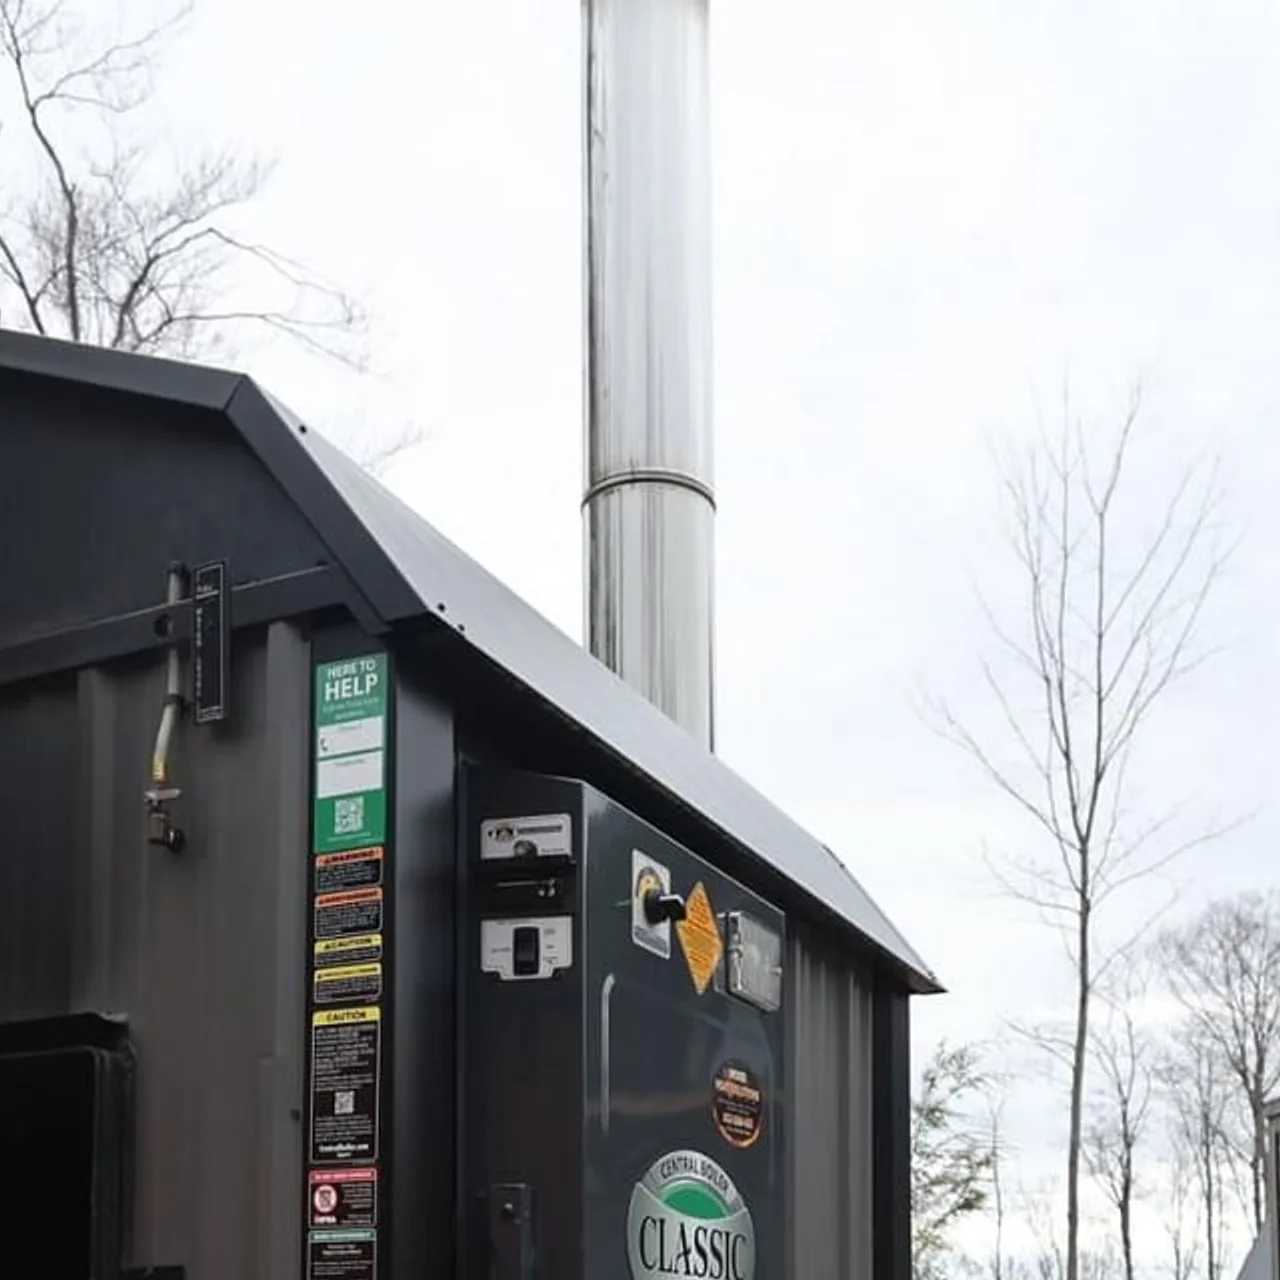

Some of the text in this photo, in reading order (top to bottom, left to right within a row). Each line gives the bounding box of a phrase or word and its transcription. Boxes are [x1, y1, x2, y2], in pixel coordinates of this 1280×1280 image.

[359, 659, 376, 676] TO
[325, 673, 378, 702] HELP
[326, 1010, 368, 1021] CAUTION
